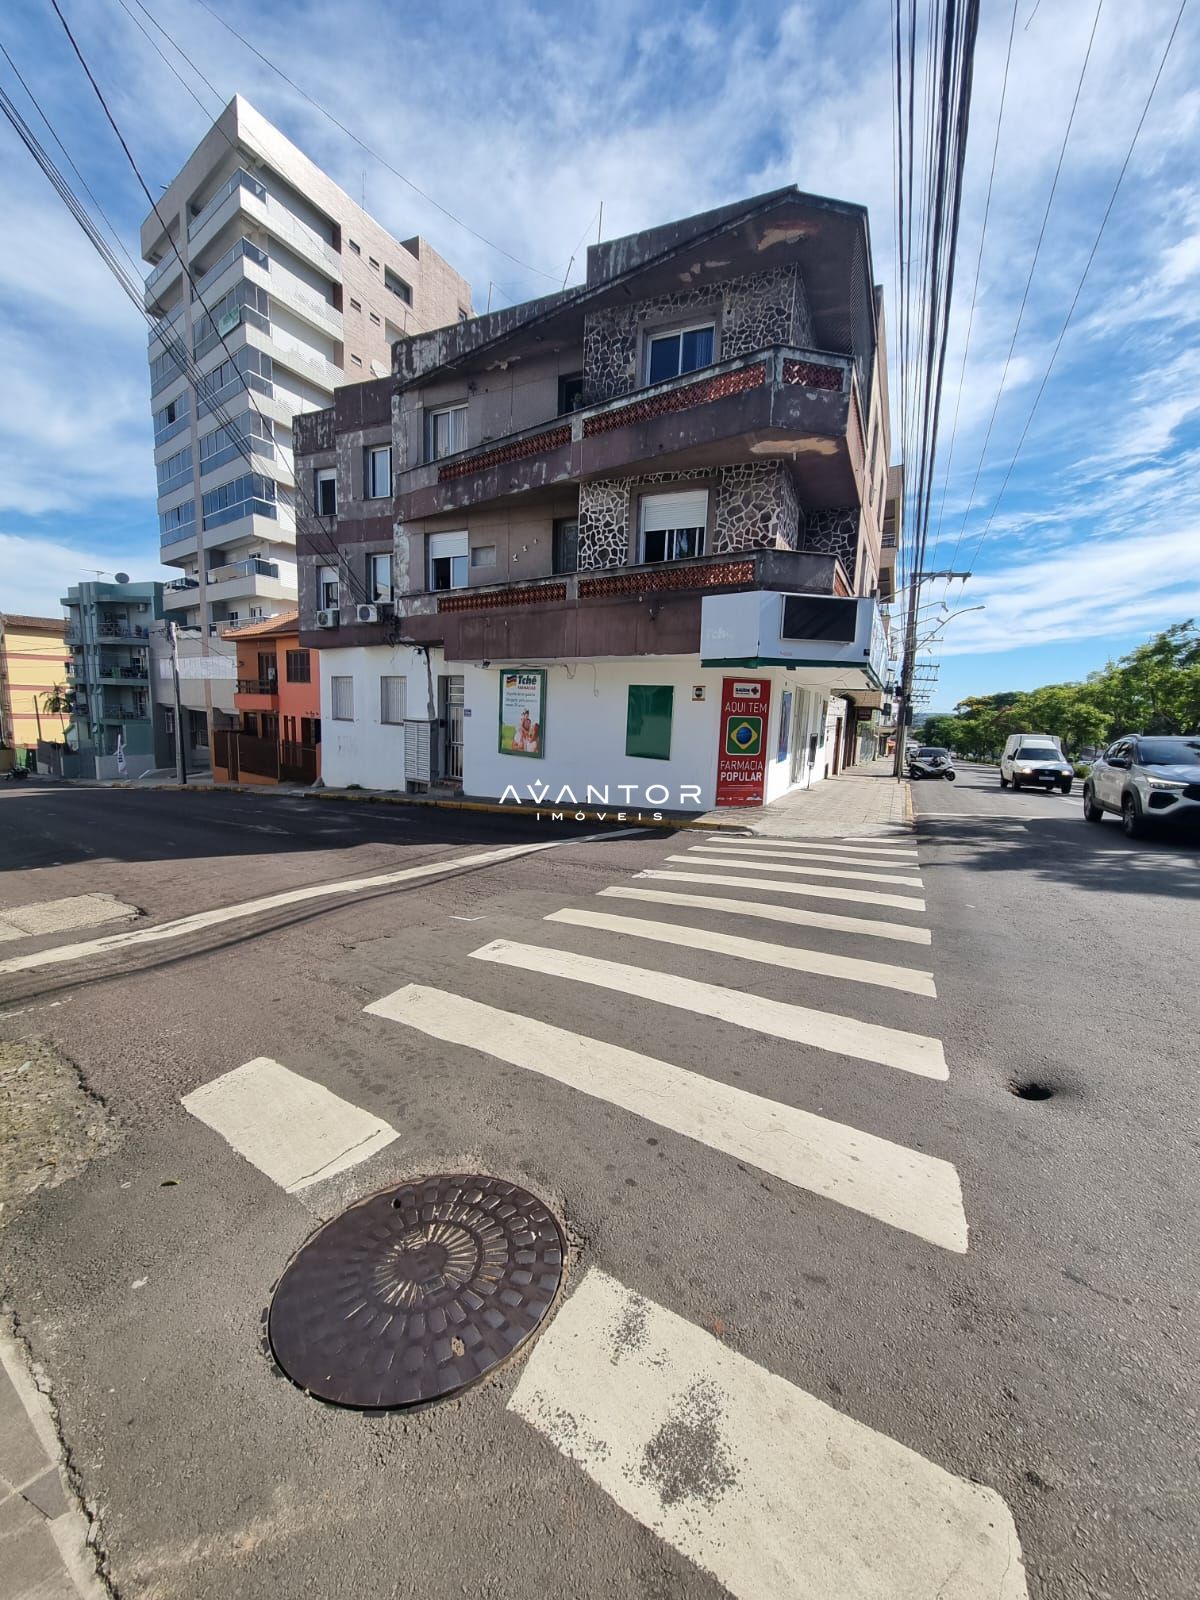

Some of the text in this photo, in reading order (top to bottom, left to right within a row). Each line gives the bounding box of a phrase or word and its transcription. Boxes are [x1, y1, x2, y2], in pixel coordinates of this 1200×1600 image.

[725, 701, 767, 713] AQUI TEM
[720, 771, 762, 781] POPULAR
